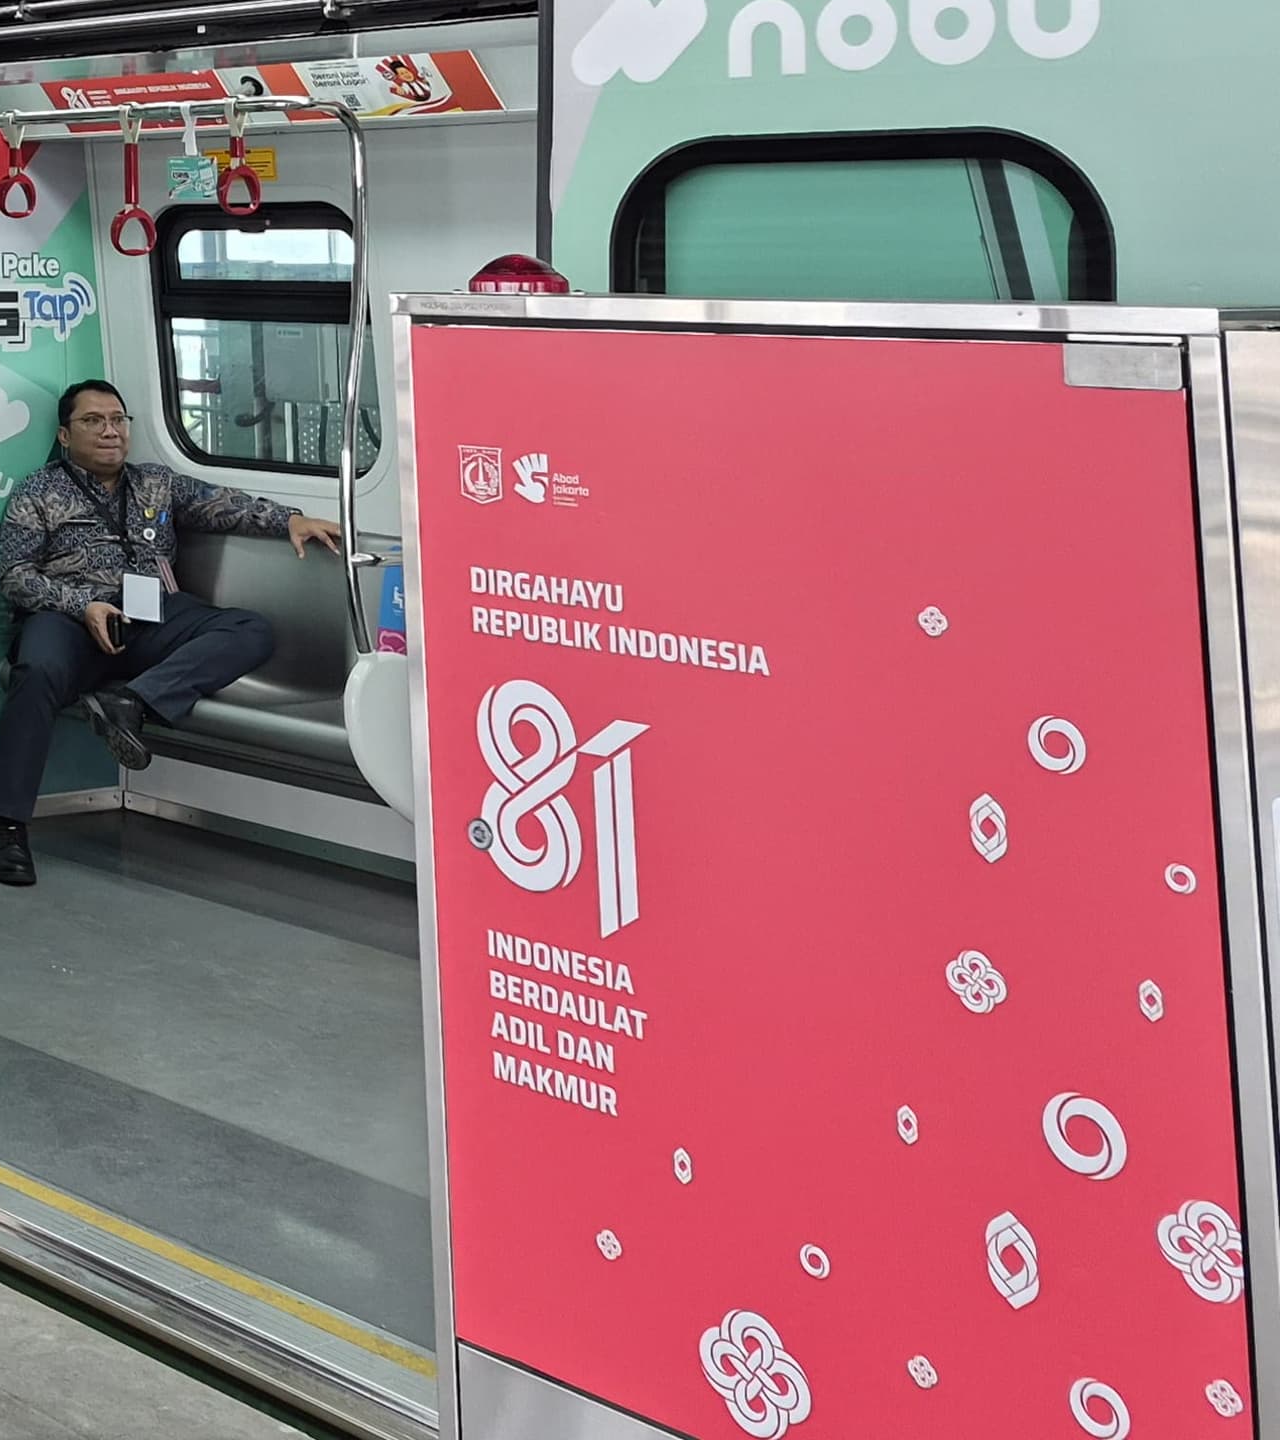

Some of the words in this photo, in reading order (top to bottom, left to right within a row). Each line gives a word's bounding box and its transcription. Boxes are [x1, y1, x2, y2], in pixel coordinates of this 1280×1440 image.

[2, 252, 61, 278] Pake
[23, 290, 80, 334] Tap
[552, 473, 579, 484] Abad
[469, 566, 625, 612] DIRGAHAYU
[471, 605, 602, 652] REPUBLIK
[608, 625, 771, 677] INDONESIA
[476, 679, 651, 939] 81
[487, 928, 635, 996] INDONESIA
[489, 969, 648, 1041] BERDAULAT
[491, 1011, 551, 1056] ADIL
[557, 1028, 615, 1074] DAN
[493, 1050, 618, 1117] MAKMUR
